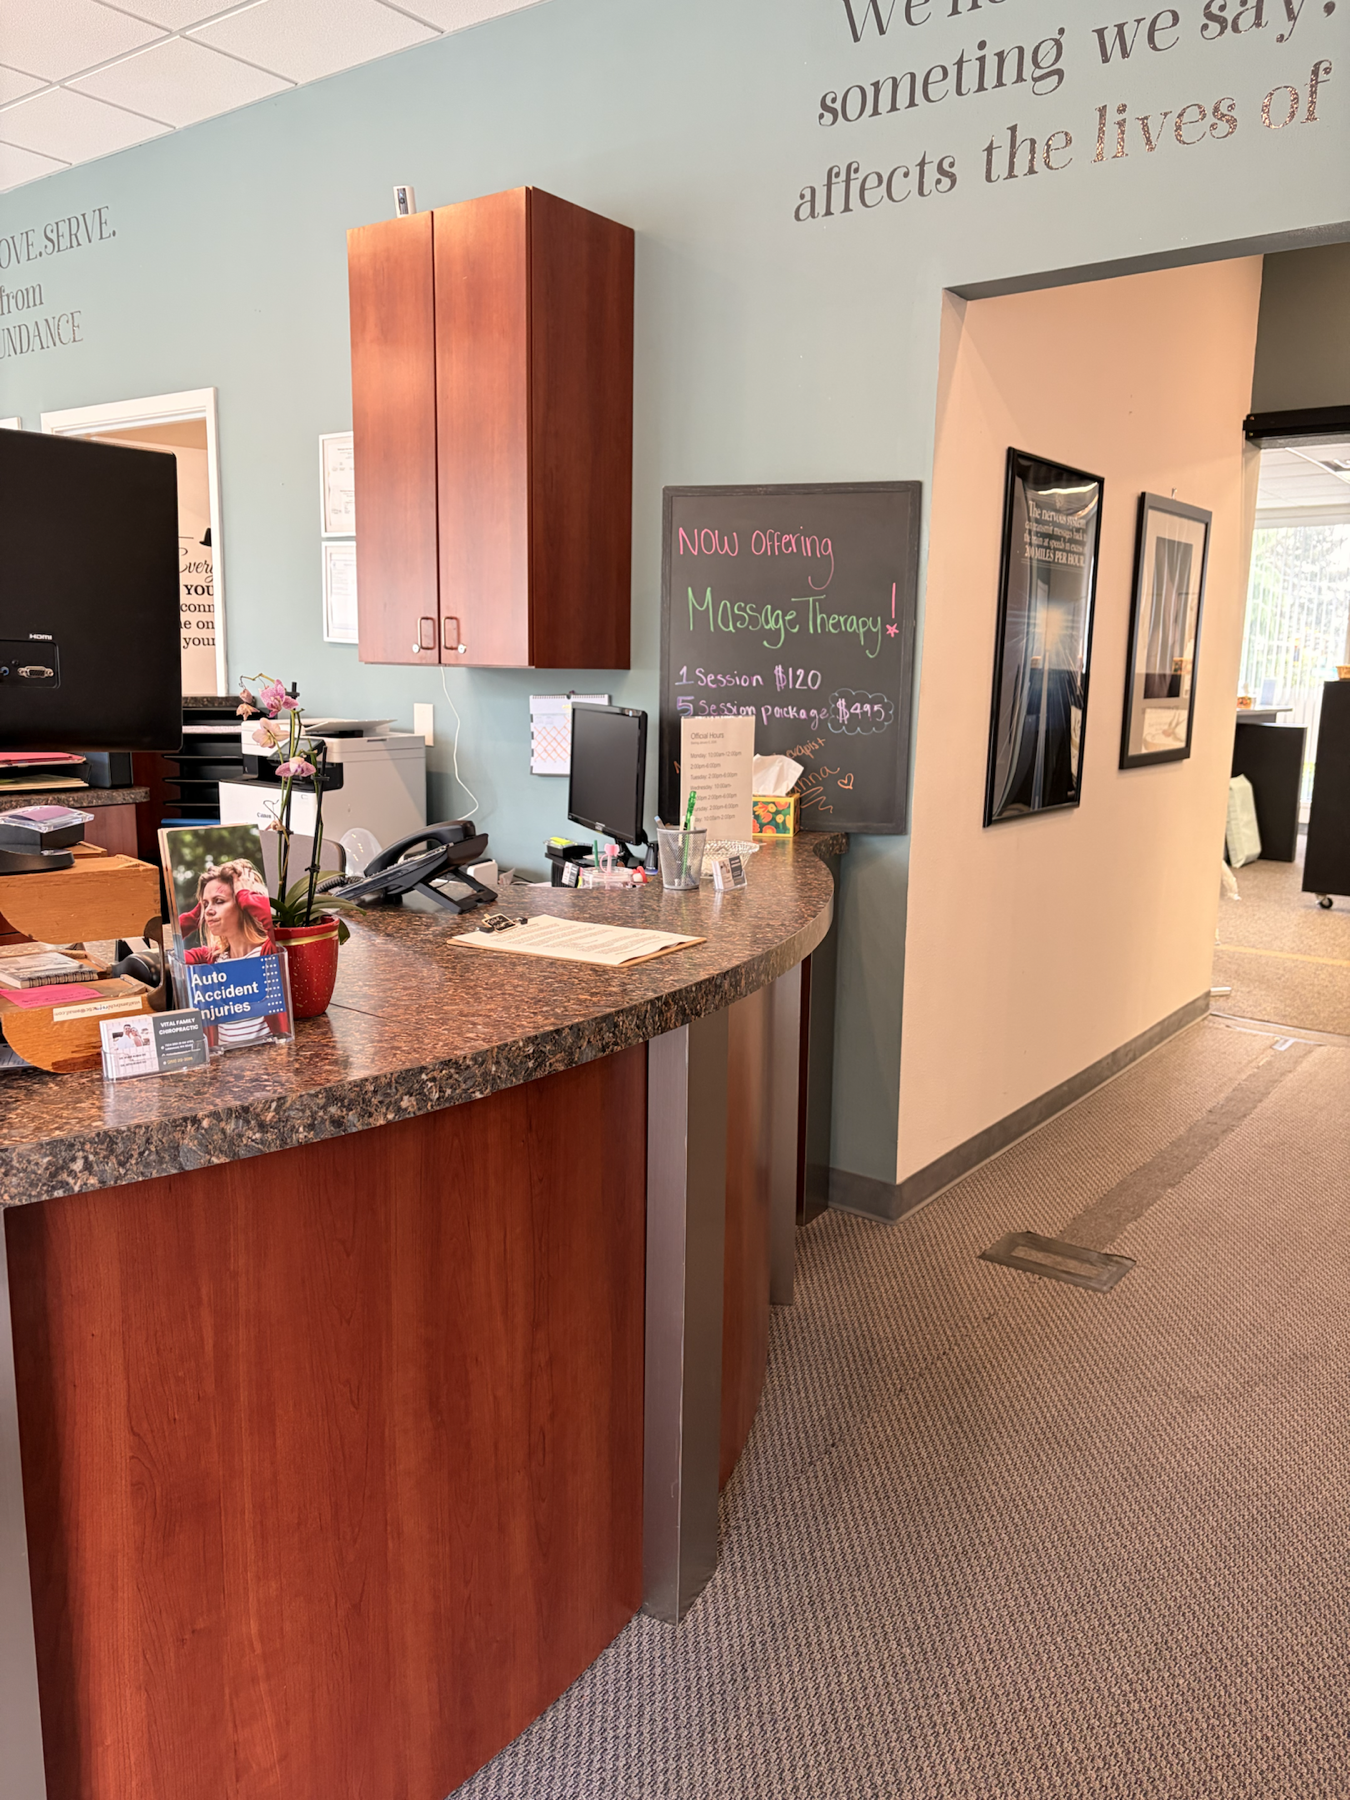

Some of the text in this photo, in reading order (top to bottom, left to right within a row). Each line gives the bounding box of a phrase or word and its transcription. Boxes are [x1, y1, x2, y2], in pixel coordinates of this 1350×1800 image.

[842, 0, 932, 43] We
[818, 27, 1065, 127] someting
[1091, 3, 1180, 64] we
[793, 59, 1332, 222] affects the lives of
[0, 283, 44, 316] from
[1029, 501, 1041, 518] The
[1042, 509, 1066, 524] nervous
[679, 527, 739, 556] NOW
[1035, 547, 1054, 562] MILES
[1055, 550, 1067, 564] PER
[688, 587, 799, 649] Massage
[674, 664, 821, 692] 1 Session $120
[676, 696, 885, 730] 5 Session package $495
[690, 732, 708, 740] Official
[191, 971, 227, 987] Auto
[193, 981, 259, 1004] Accident
[160, 1018, 195, 1028] VITAL FAMILY
[200, 1001, 251, 1021] njuries
[159, 1024, 199, 1035] CHIROPRACTIC
